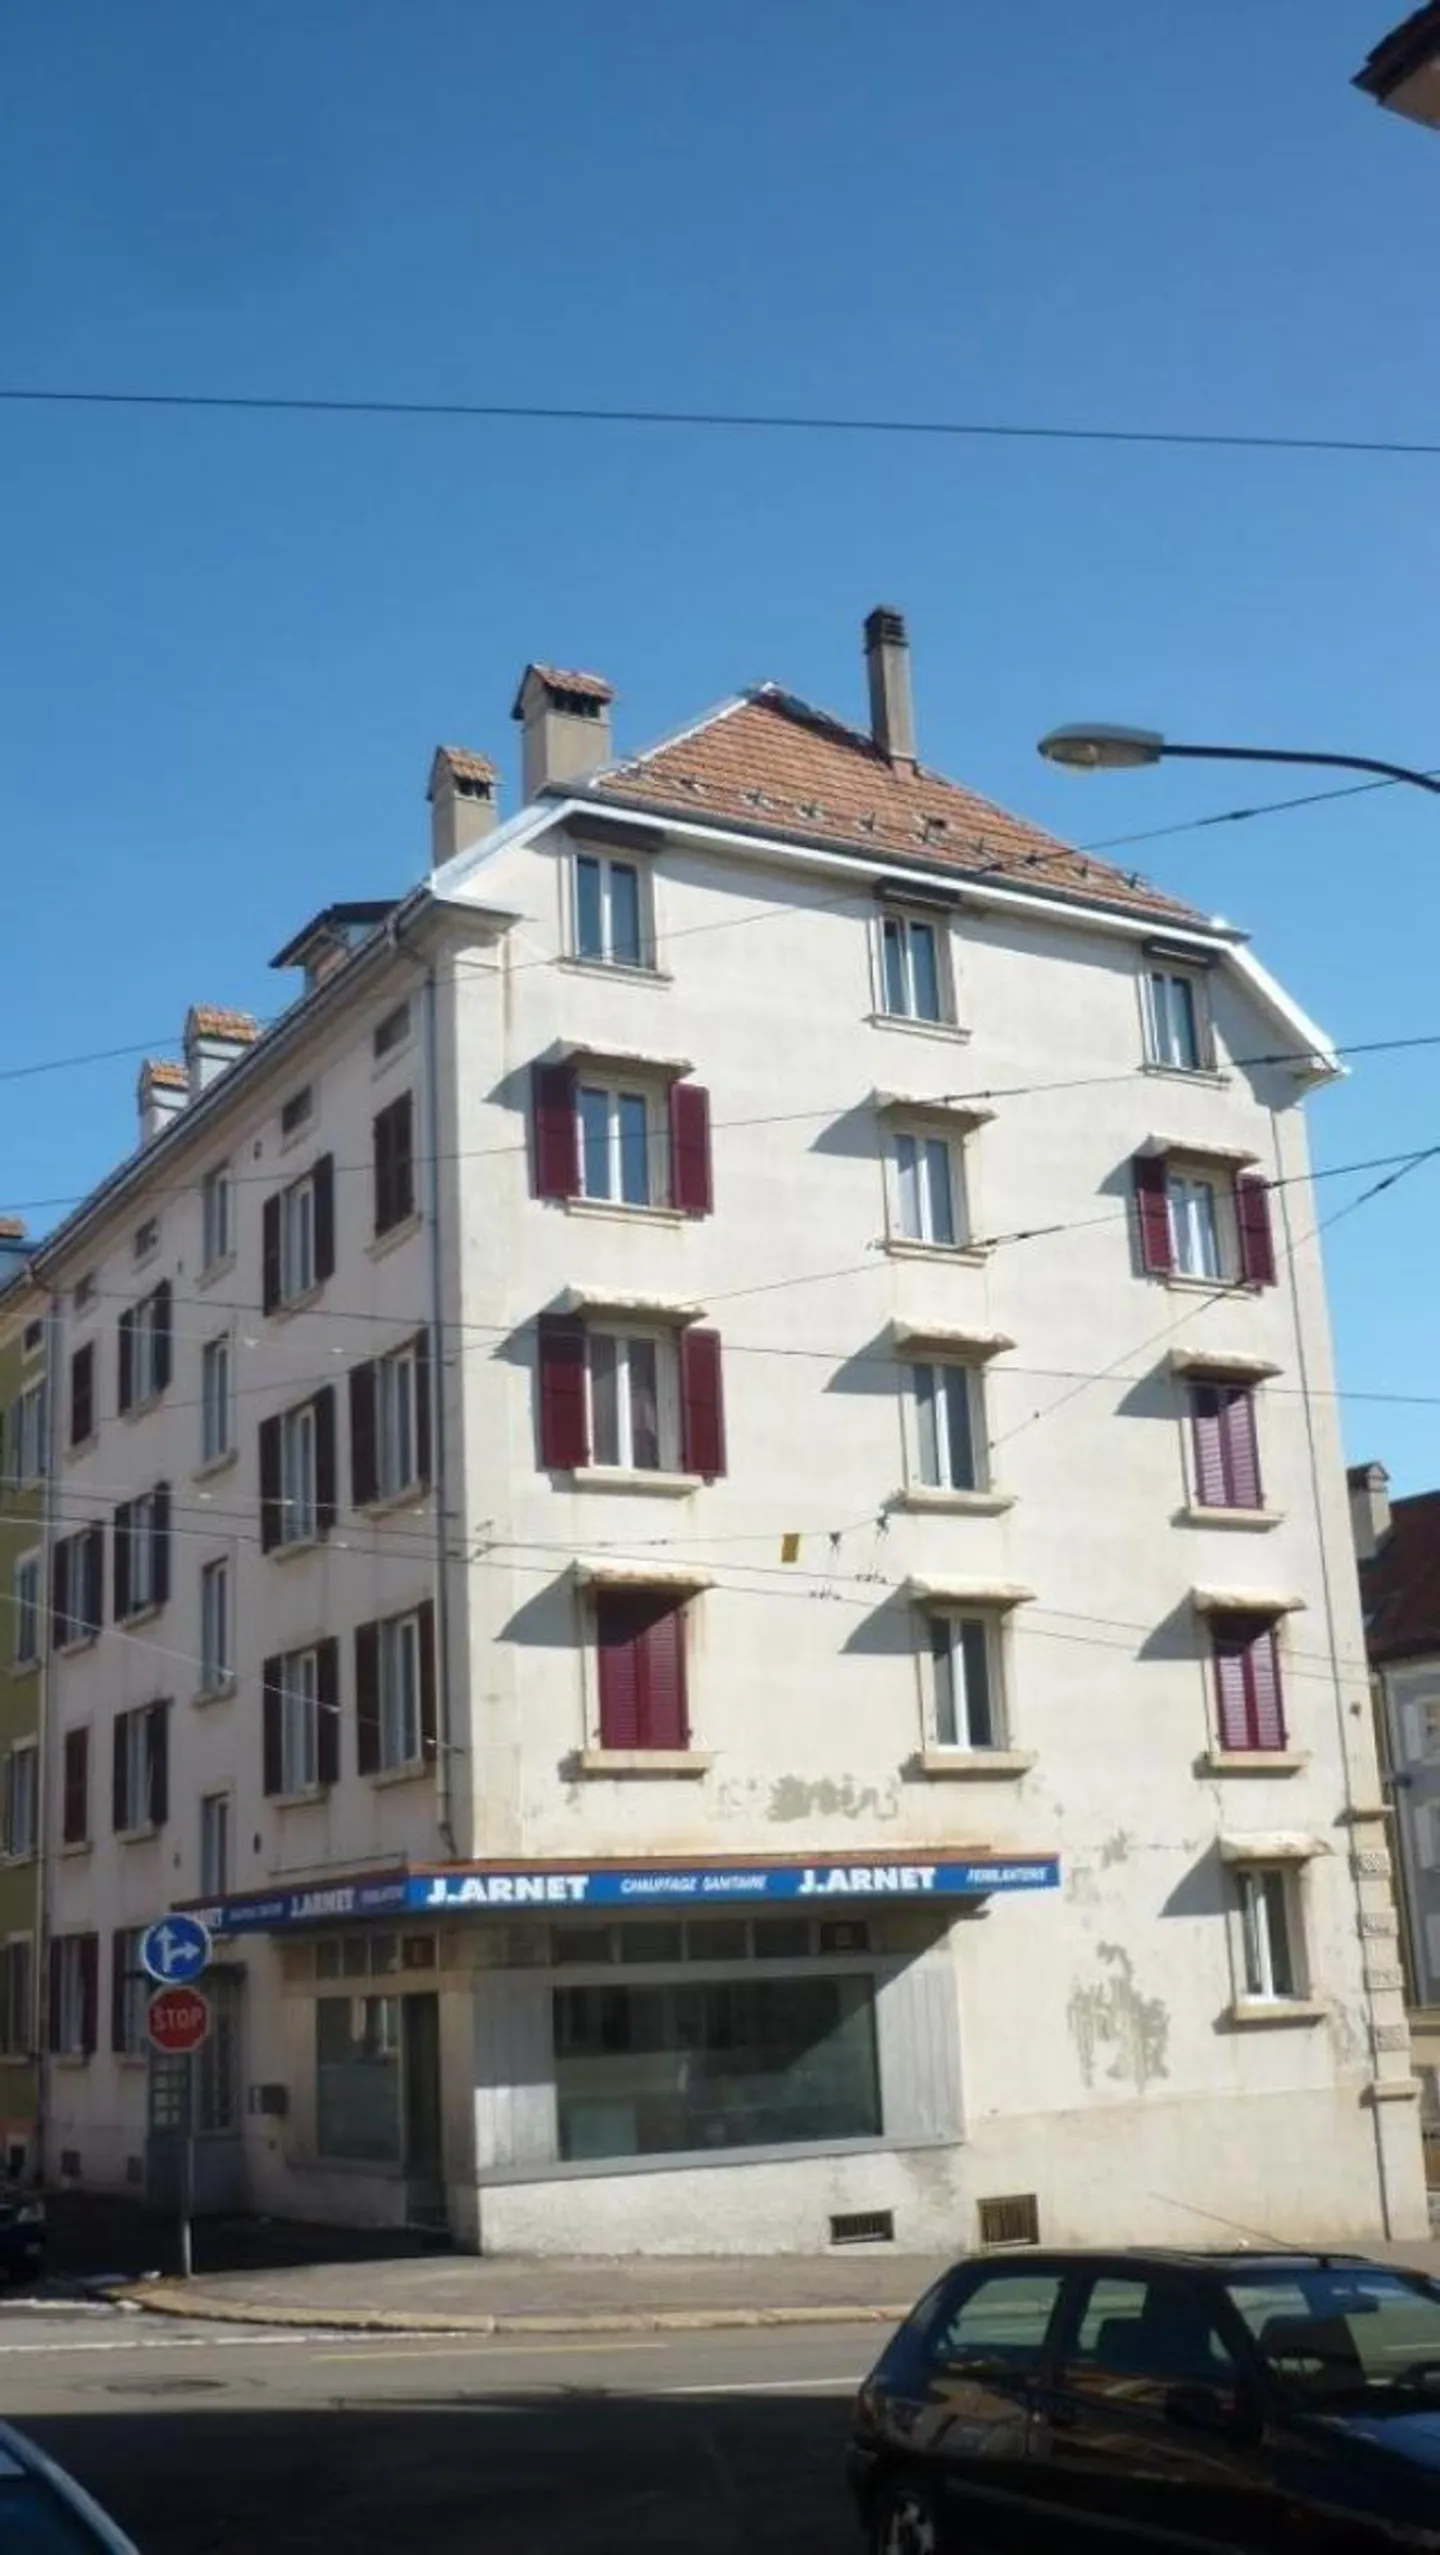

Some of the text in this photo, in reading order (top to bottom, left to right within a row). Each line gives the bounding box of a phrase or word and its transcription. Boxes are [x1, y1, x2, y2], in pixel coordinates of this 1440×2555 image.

[427, 1876, 589, 1904] J.ARNET
[797, 1866, 936, 1894] J.ARNET
[152, 2006, 203, 2032] STOP
